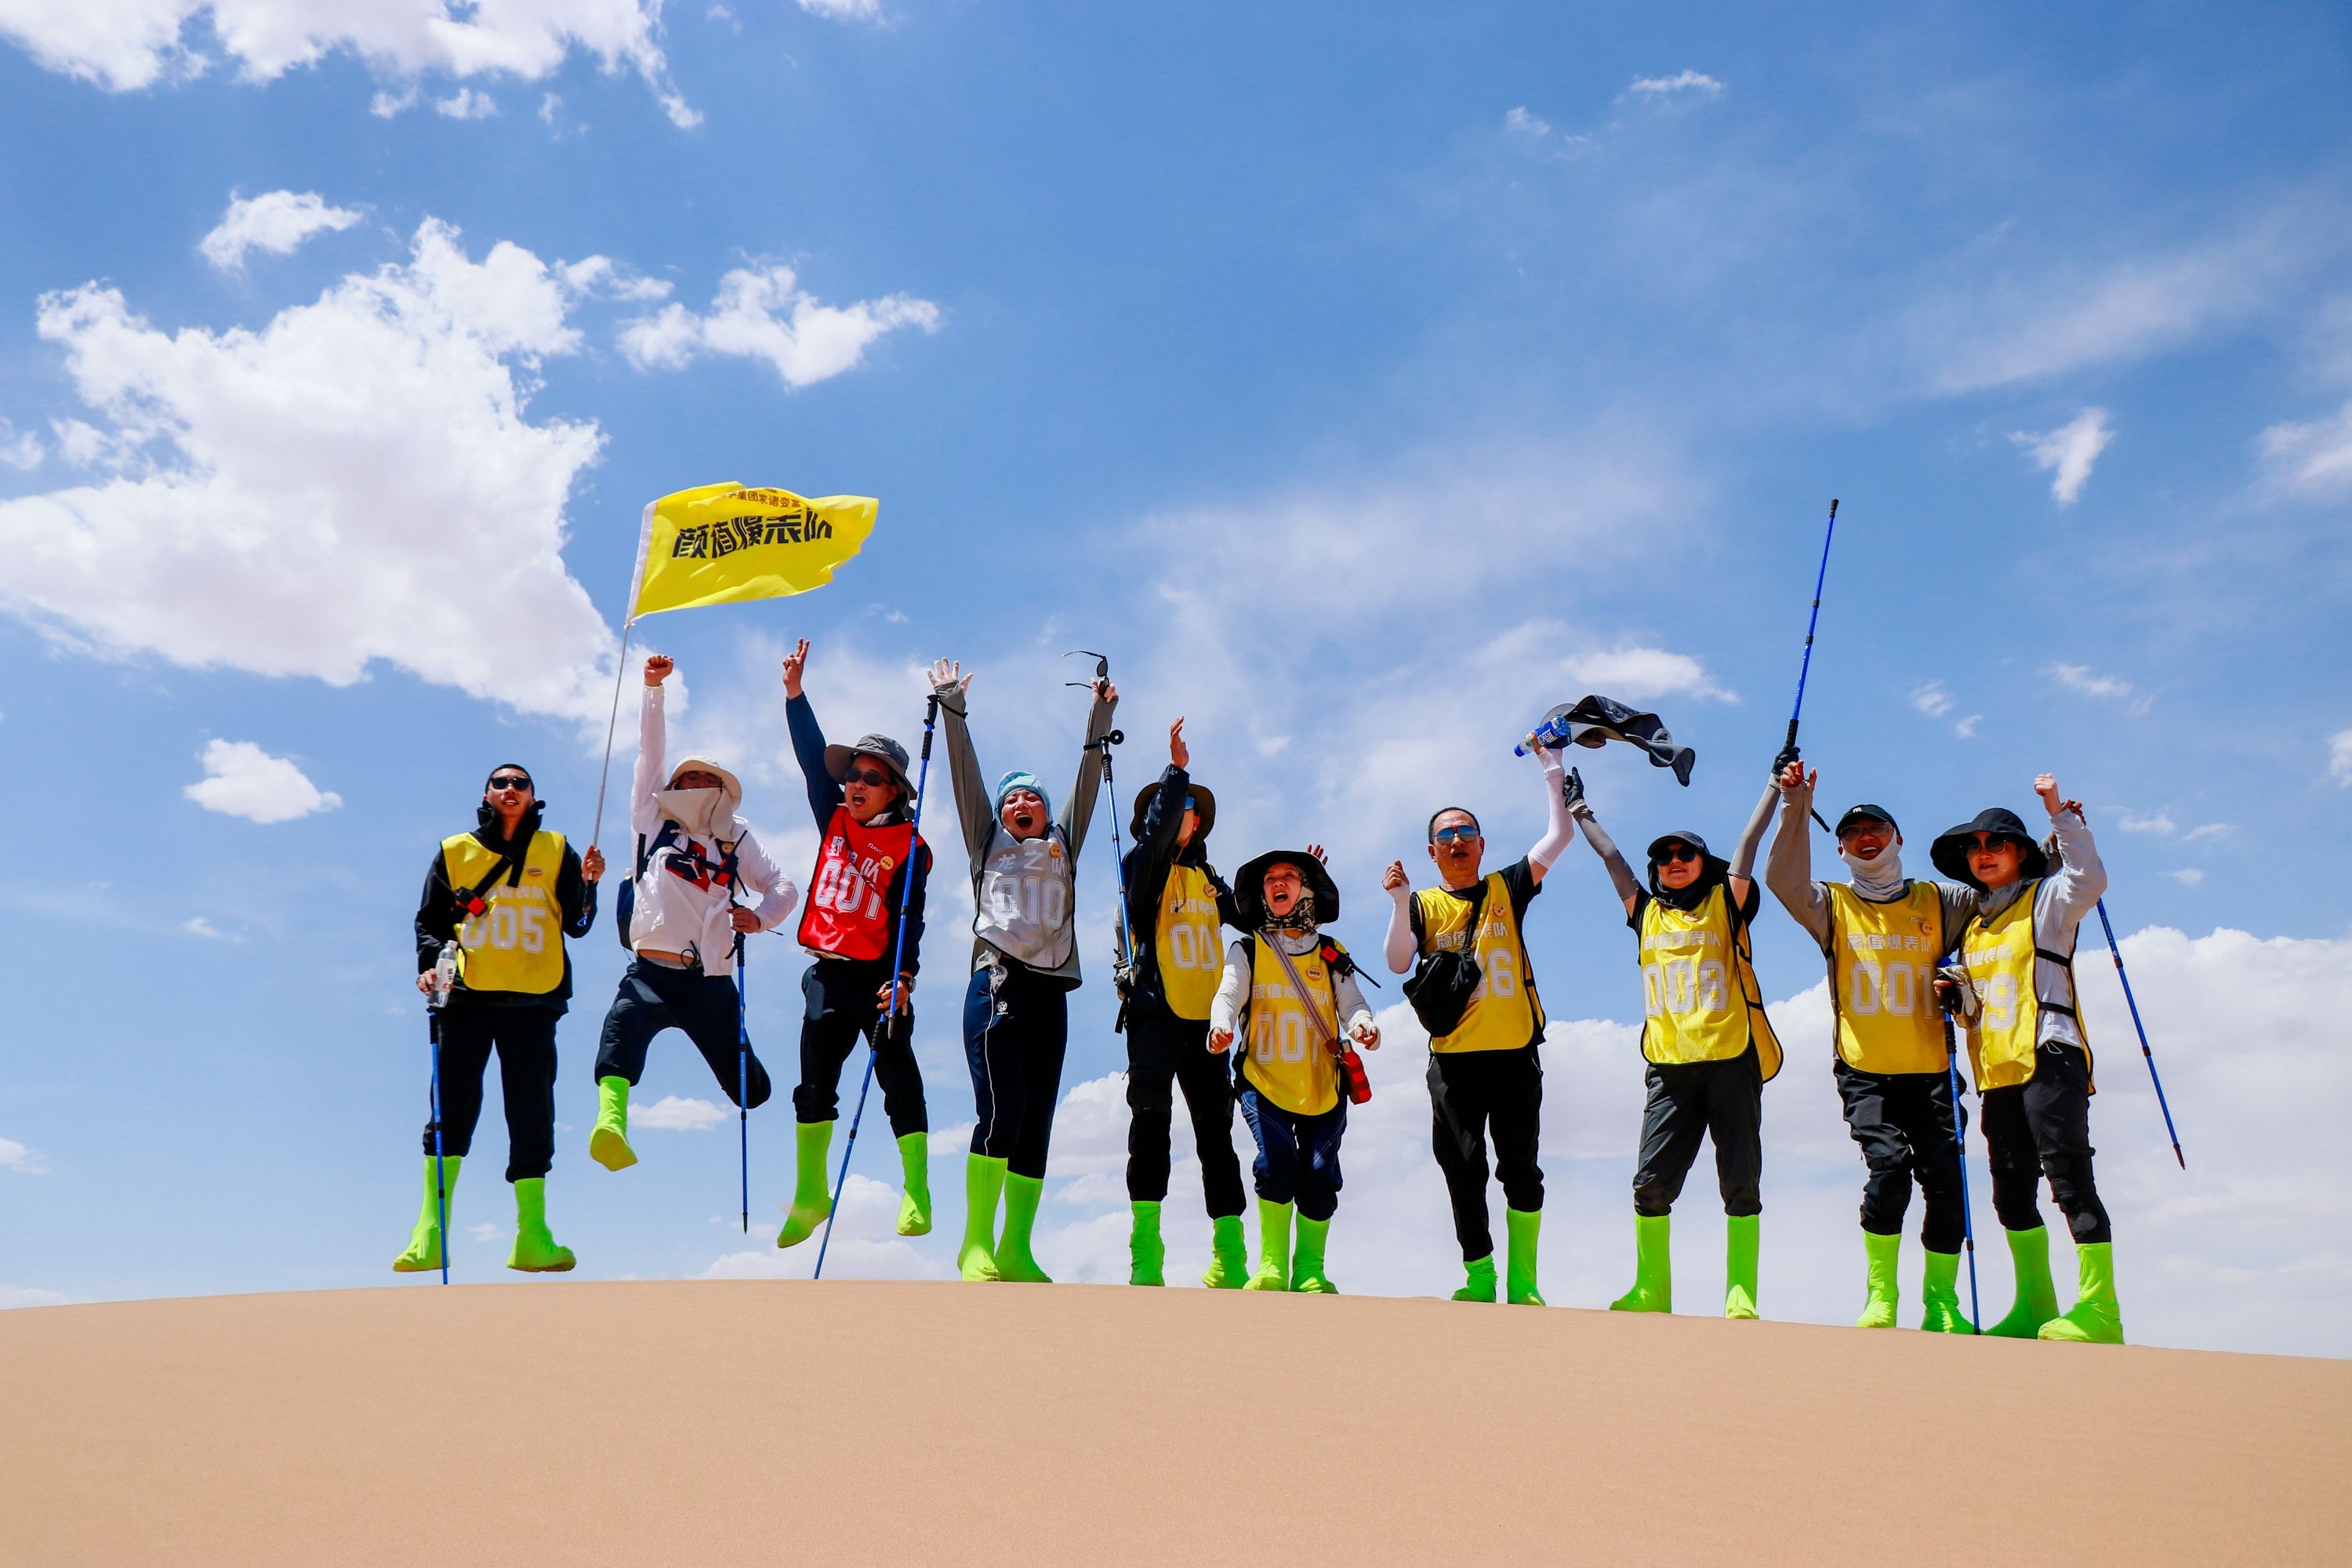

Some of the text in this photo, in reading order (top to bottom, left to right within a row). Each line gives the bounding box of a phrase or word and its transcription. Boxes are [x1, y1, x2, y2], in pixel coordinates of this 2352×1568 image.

[815, 858, 882, 920] 001
[993, 875, 1066, 930] 010
[460, 906, 547, 954] 005
[1847, 934, 1933, 954] 颜值爆表队
[1642, 958, 1729, 1019] 008
[1850, 960, 1933, 1019] 001
